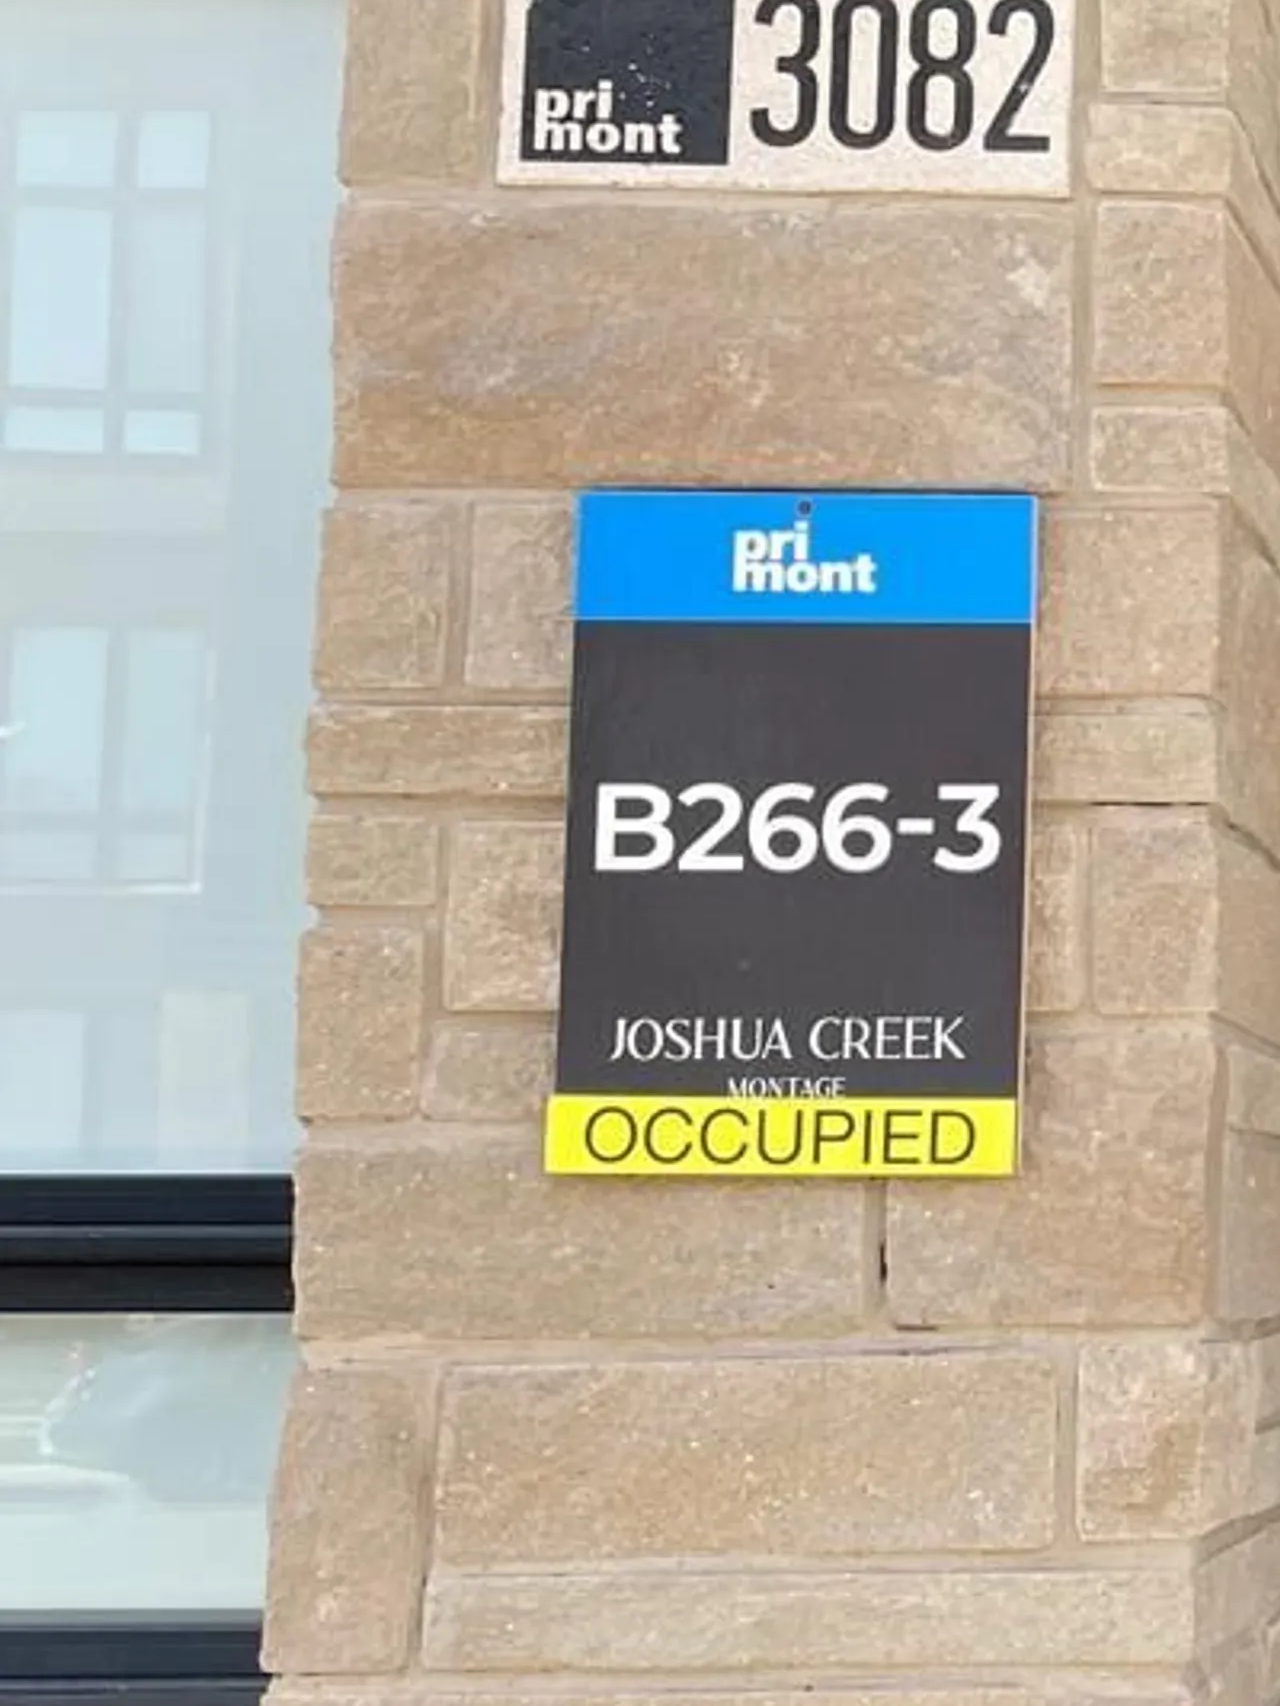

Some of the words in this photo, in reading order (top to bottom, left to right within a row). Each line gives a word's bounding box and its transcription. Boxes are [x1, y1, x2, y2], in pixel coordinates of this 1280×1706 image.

[534, 80, 613, 122] pri
[533, 115, 682, 154] mont
[733, 520, 808, 565] pri
[732, 554, 877, 593] mont
[594, 782, 1001, 872] B266-3
[610, 1017, 793, 1061] JOSHUA
[809, 1016, 966, 1061] CREEK
[727, 1077, 846, 1099] MONTAGE
[584, 1106, 976, 1165] OCCUPIED
